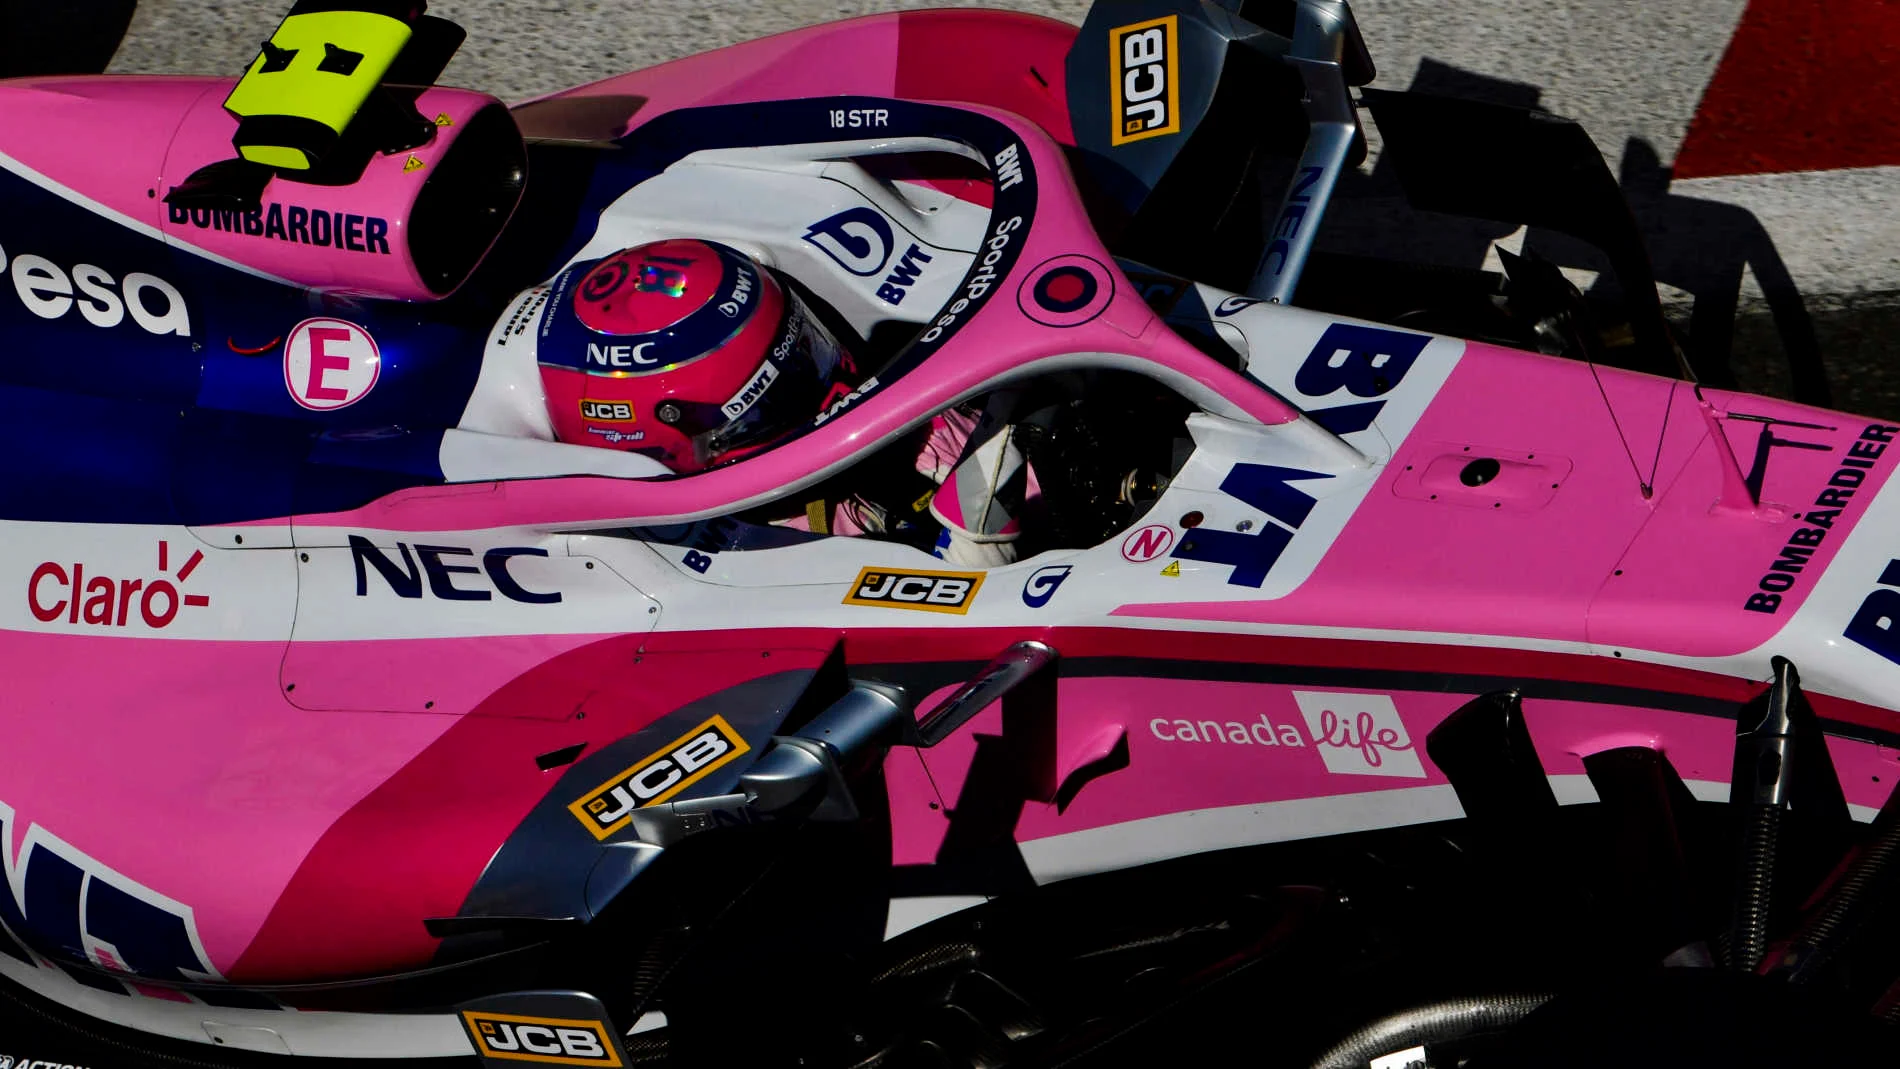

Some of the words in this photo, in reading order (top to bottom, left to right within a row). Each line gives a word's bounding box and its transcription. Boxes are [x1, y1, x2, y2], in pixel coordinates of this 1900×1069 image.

[1125, 28, 1165, 128] JCB
[830, 110, 845, 128] 18
[849, 110, 889, 127] STR
[994, 143, 1023, 191] BWT
[1258, 166, 1324, 276] NEC
[0, 243, 191, 337] esa
[731, 267, 753, 305] BWT
[876, 243, 932, 306] BWT
[919, 216, 1022, 343] SportPesa
[303, 328, 350, 400] E
[586, 342, 658, 366] NEC
[584, 403, 631, 419] JCB
[740, 370, 773, 402] BWT
[1129, 529, 1166, 558] N
[1744, 424, 1900, 614] BOMBARDIER
[27, 561, 179, 628] Claro
[348, 535, 562, 604] NEC
[858, 575, 969, 605] JCB
[1150, 714, 1305, 748] canada
[1314, 711, 1412, 767] life
[597, 730, 729, 823] JCB
[486, 1023, 604, 1057] JCB
